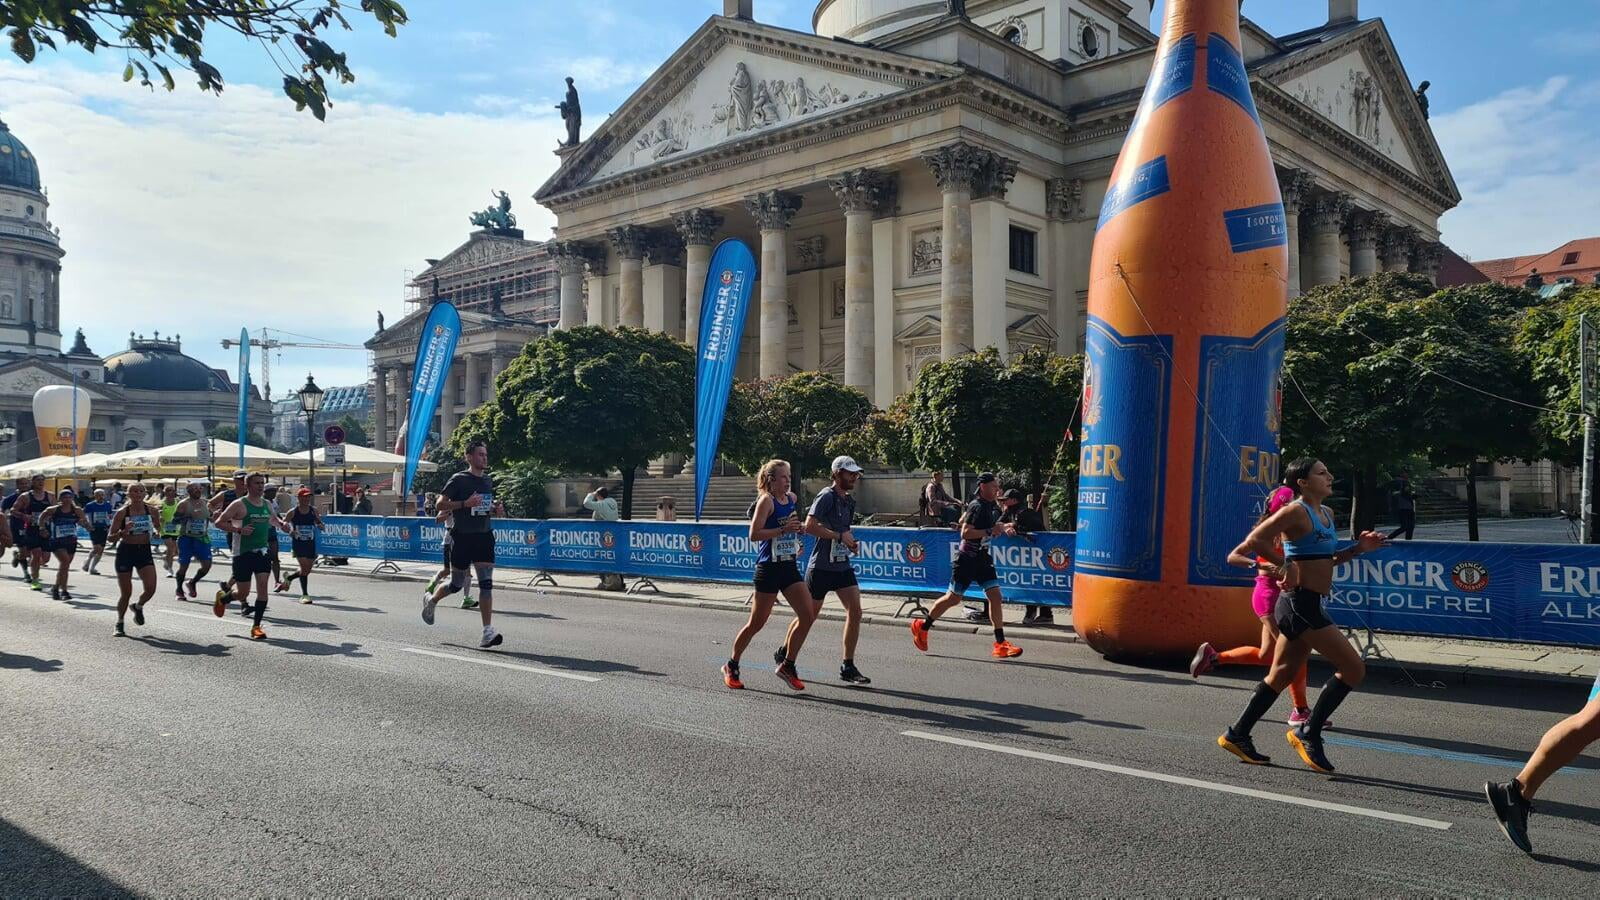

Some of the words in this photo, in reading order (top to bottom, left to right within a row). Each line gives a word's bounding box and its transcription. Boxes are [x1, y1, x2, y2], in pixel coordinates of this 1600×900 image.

[703, 286, 731, 360] ERDINGER
[720, 270, 743, 362] ALKOHOLFREI
[416, 336, 441, 393] ERDINGER
[1080, 444, 1126, 481] GER
[366, 523, 401, 539] ERDINGER
[549, 528, 602, 548] ERDINGER
[630, 530, 688, 552] ERDINGER
[366, 541, 410, 550] ALKOHOLFREI
[550, 549, 616, 560] ALKOHOLFREI
[629, 552, 703, 565] ALKOHOLFREI
